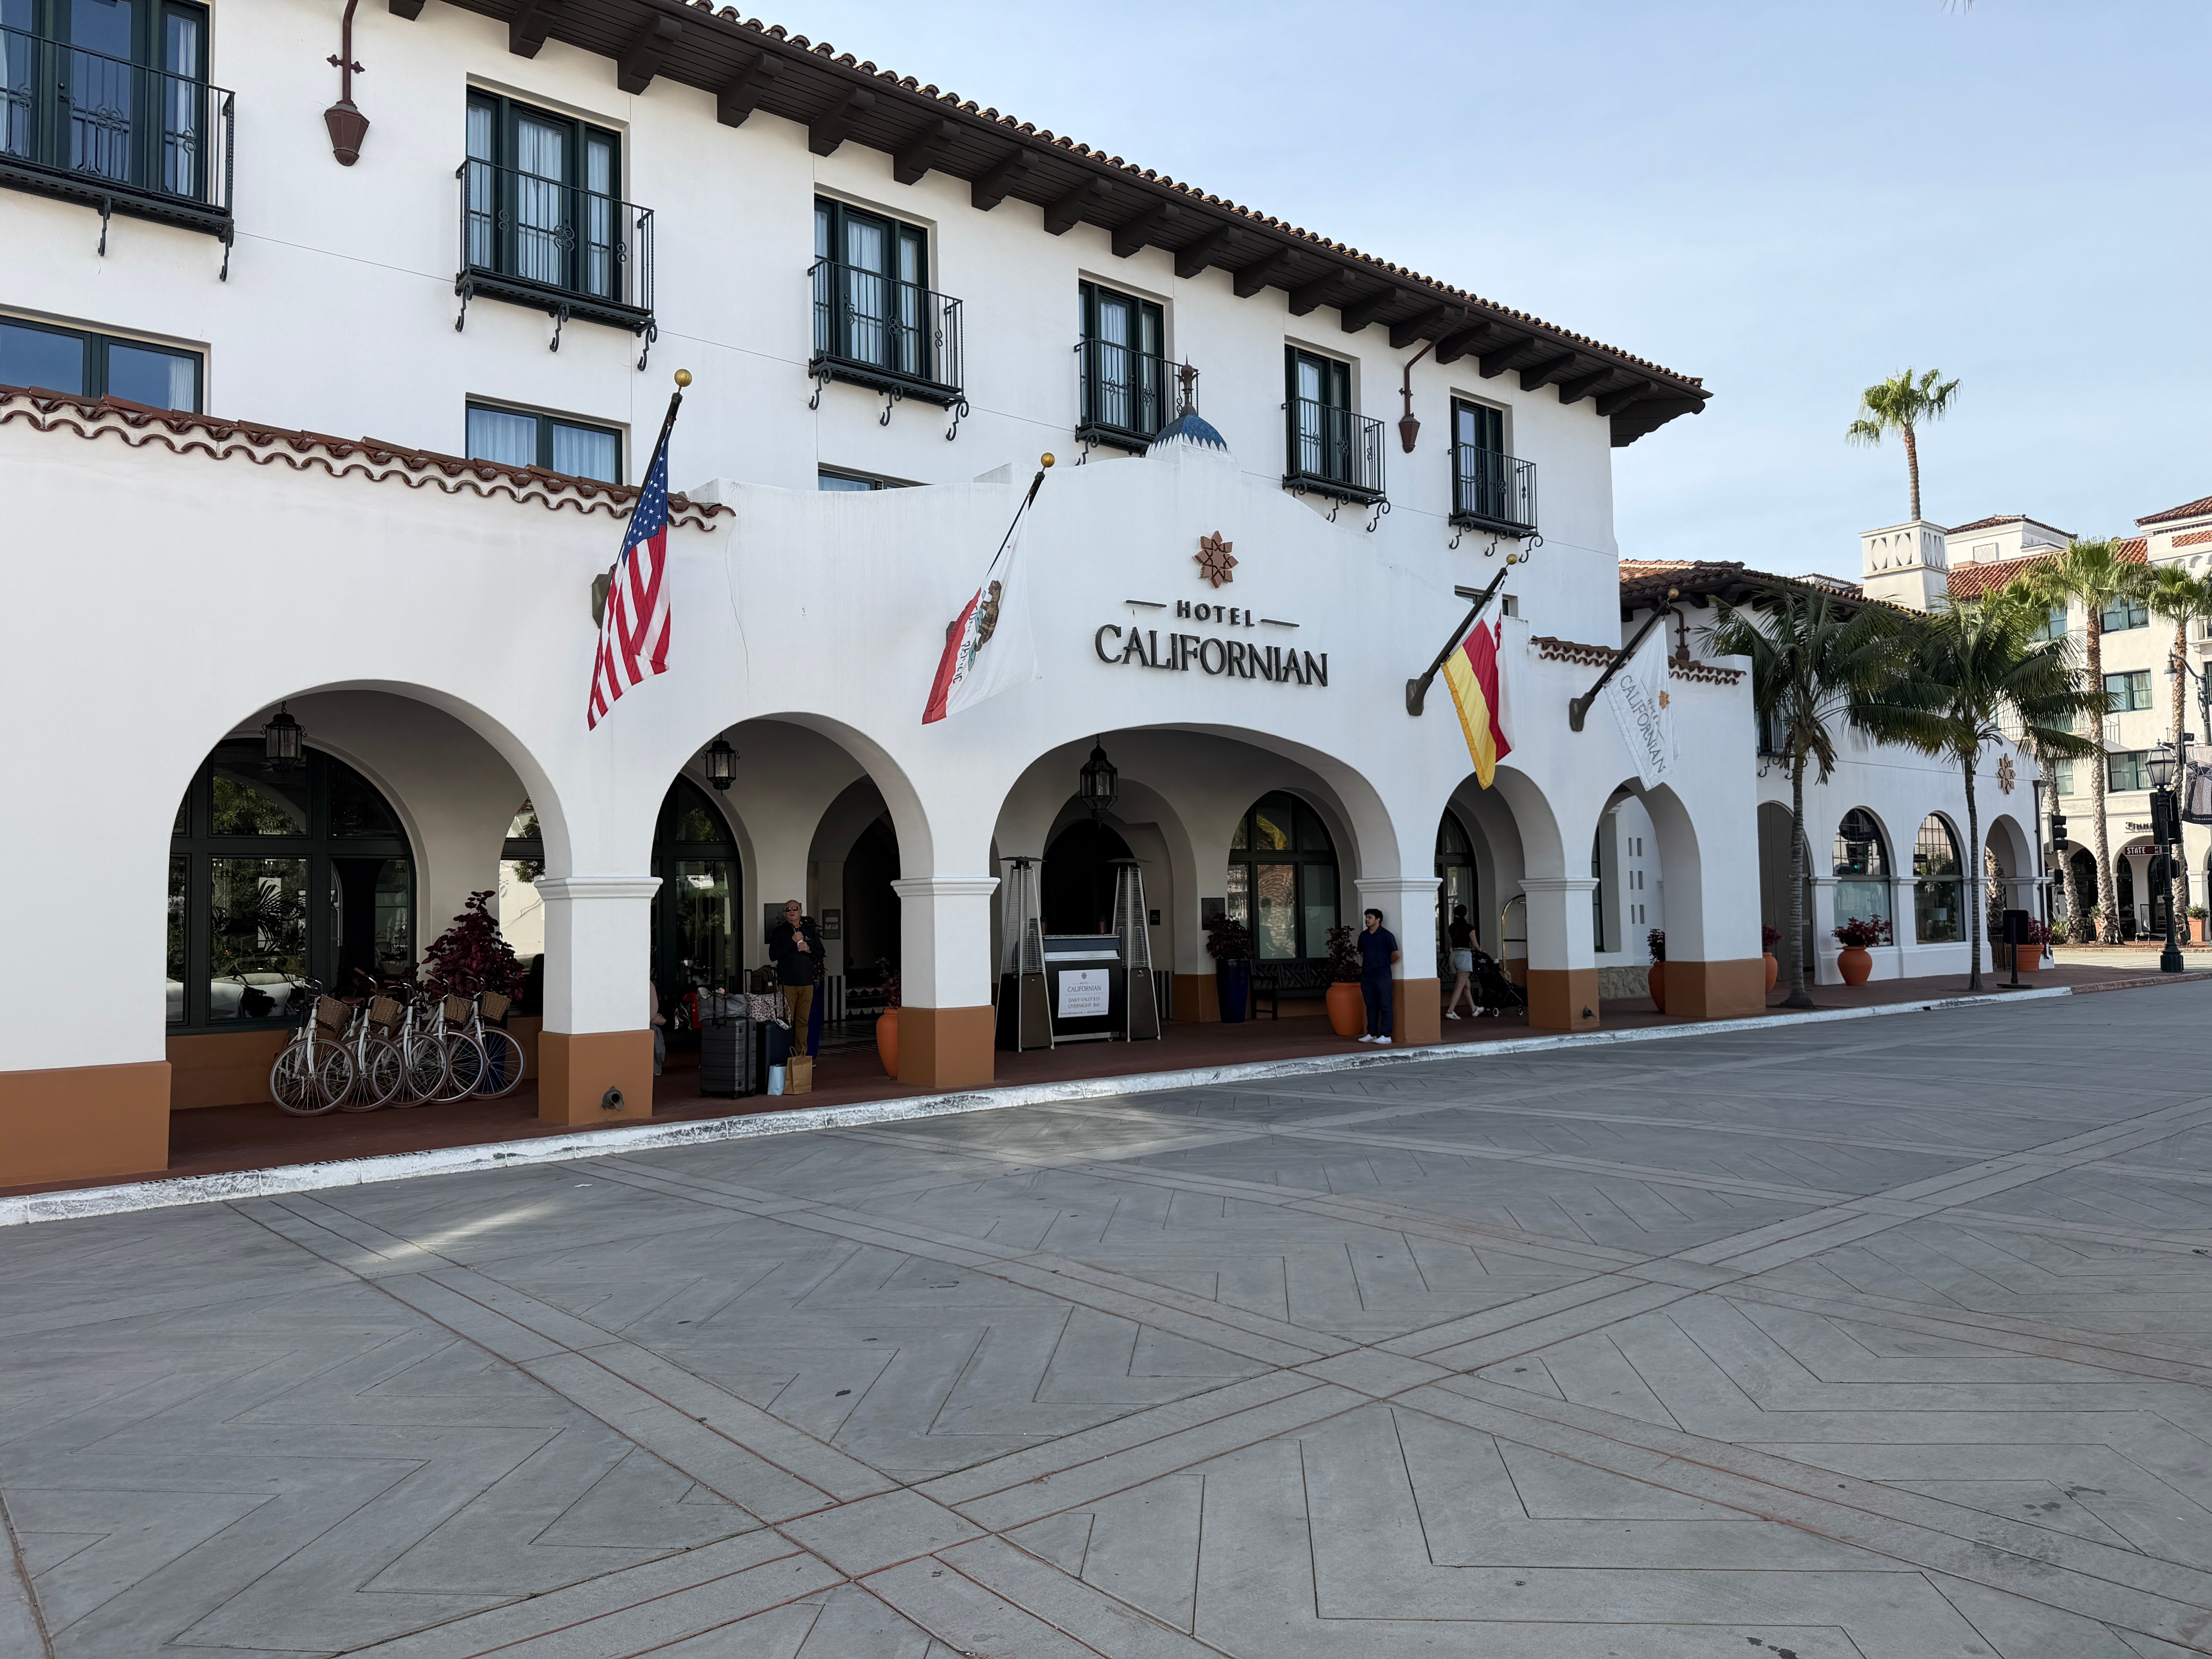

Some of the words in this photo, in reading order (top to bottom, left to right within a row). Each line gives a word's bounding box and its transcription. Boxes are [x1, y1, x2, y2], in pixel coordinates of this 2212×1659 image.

[1177, 599, 1255, 627] HOTEL
[1095, 624, 1328, 687] CALIFORNIAN
[1620, 675, 1666, 773] CALIFORNIAN
